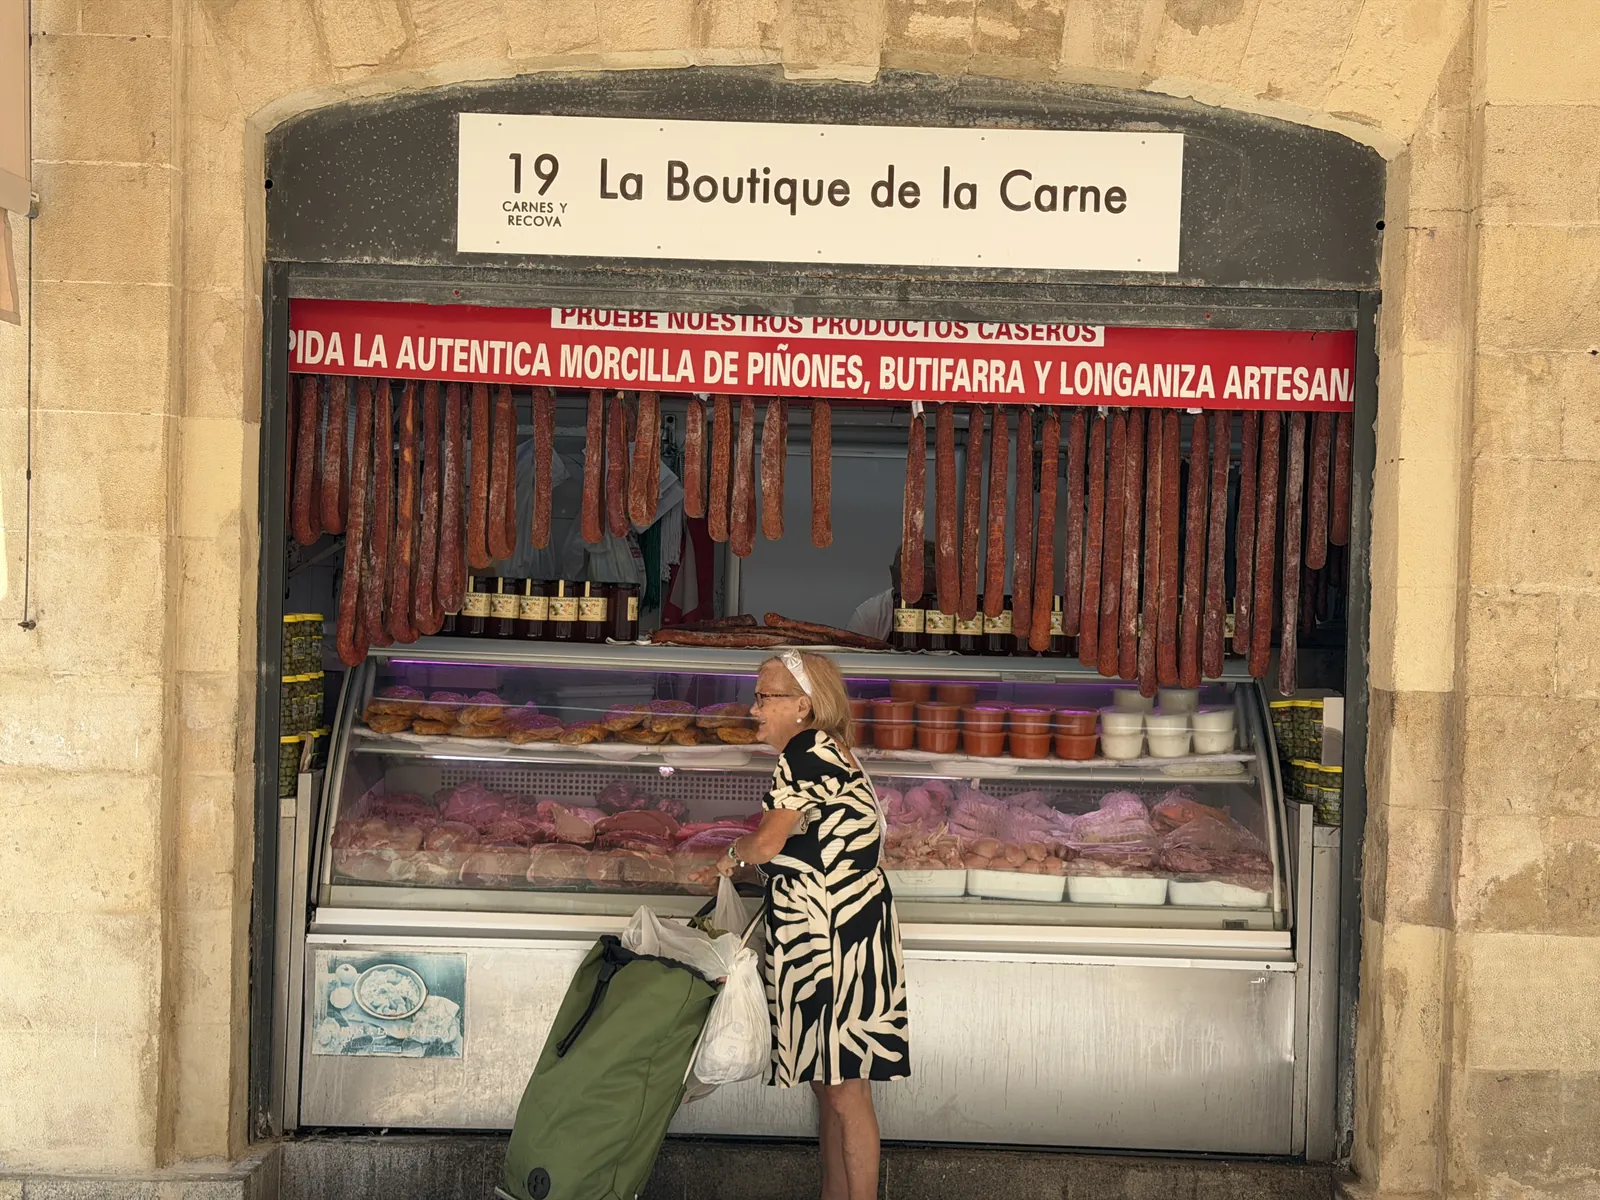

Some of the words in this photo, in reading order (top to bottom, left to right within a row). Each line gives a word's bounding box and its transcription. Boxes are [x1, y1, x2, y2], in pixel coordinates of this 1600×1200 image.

[508, 152, 559, 196] 19
[600, 157, 643, 201] La
[666, 160, 851, 216] Boutique
[870, 164, 921, 209] de
[942, 165, 978, 210] la
[999, 169, 1128, 214] Carne
[502, 200, 554, 214] CARNES
[559, 202, 568, 214] Y
[507, 214, 562, 228] RECOVA
[560, 308, 659, 329] PRUEBE
[667, 312, 803, 334] NUESTROS
[812, 317, 969, 339] PRODUCTOS
[977, 324, 1097, 343] CASEROS
[353, 333, 388, 369] LA
[395, 335, 552, 378] AUTENTICA
[559, 343, 696, 384] MORCILLA
[703, 350, 739, 385] DE
[747, 343, 871, 395] PIÑONES,
[879, 355, 1026, 394] BUTIFARRA
[1033, 360, 1053, 395] Y
[1059, 361, 1216, 399] LONGANIZA
[1222, 365, 1354, 403] ARTESAN
